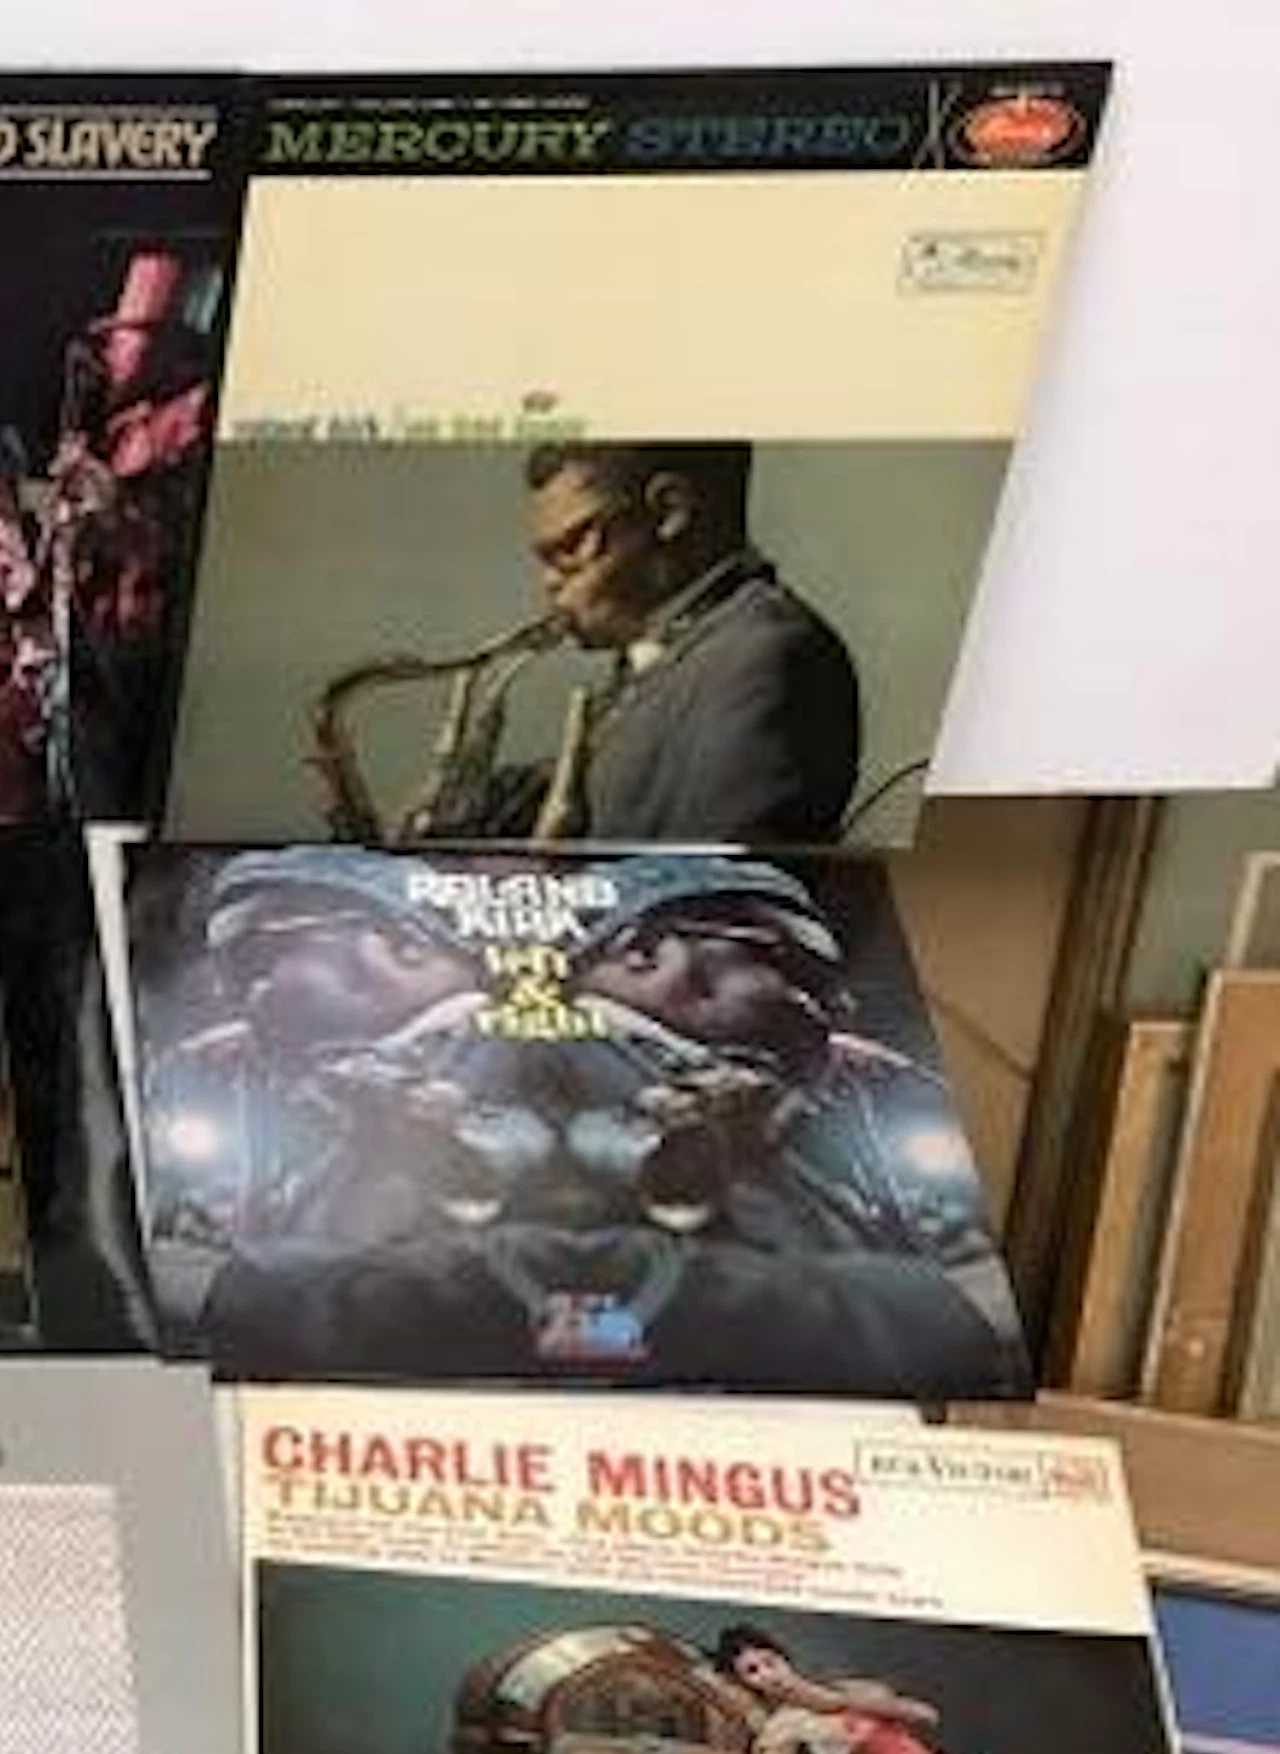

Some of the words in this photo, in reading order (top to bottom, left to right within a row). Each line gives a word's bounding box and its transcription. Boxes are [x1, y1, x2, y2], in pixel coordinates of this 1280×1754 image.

[23, 117, 218, 169] SLAVERY
[262, 120, 613, 164] MERCURY
[261, 1424, 557, 1494] CHARLIE
[585, 1448, 862, 1519] MINGUS
[260, 1472, 554, 1528] TIJUANA
[573, 1499, 834, 1554] MOODS
